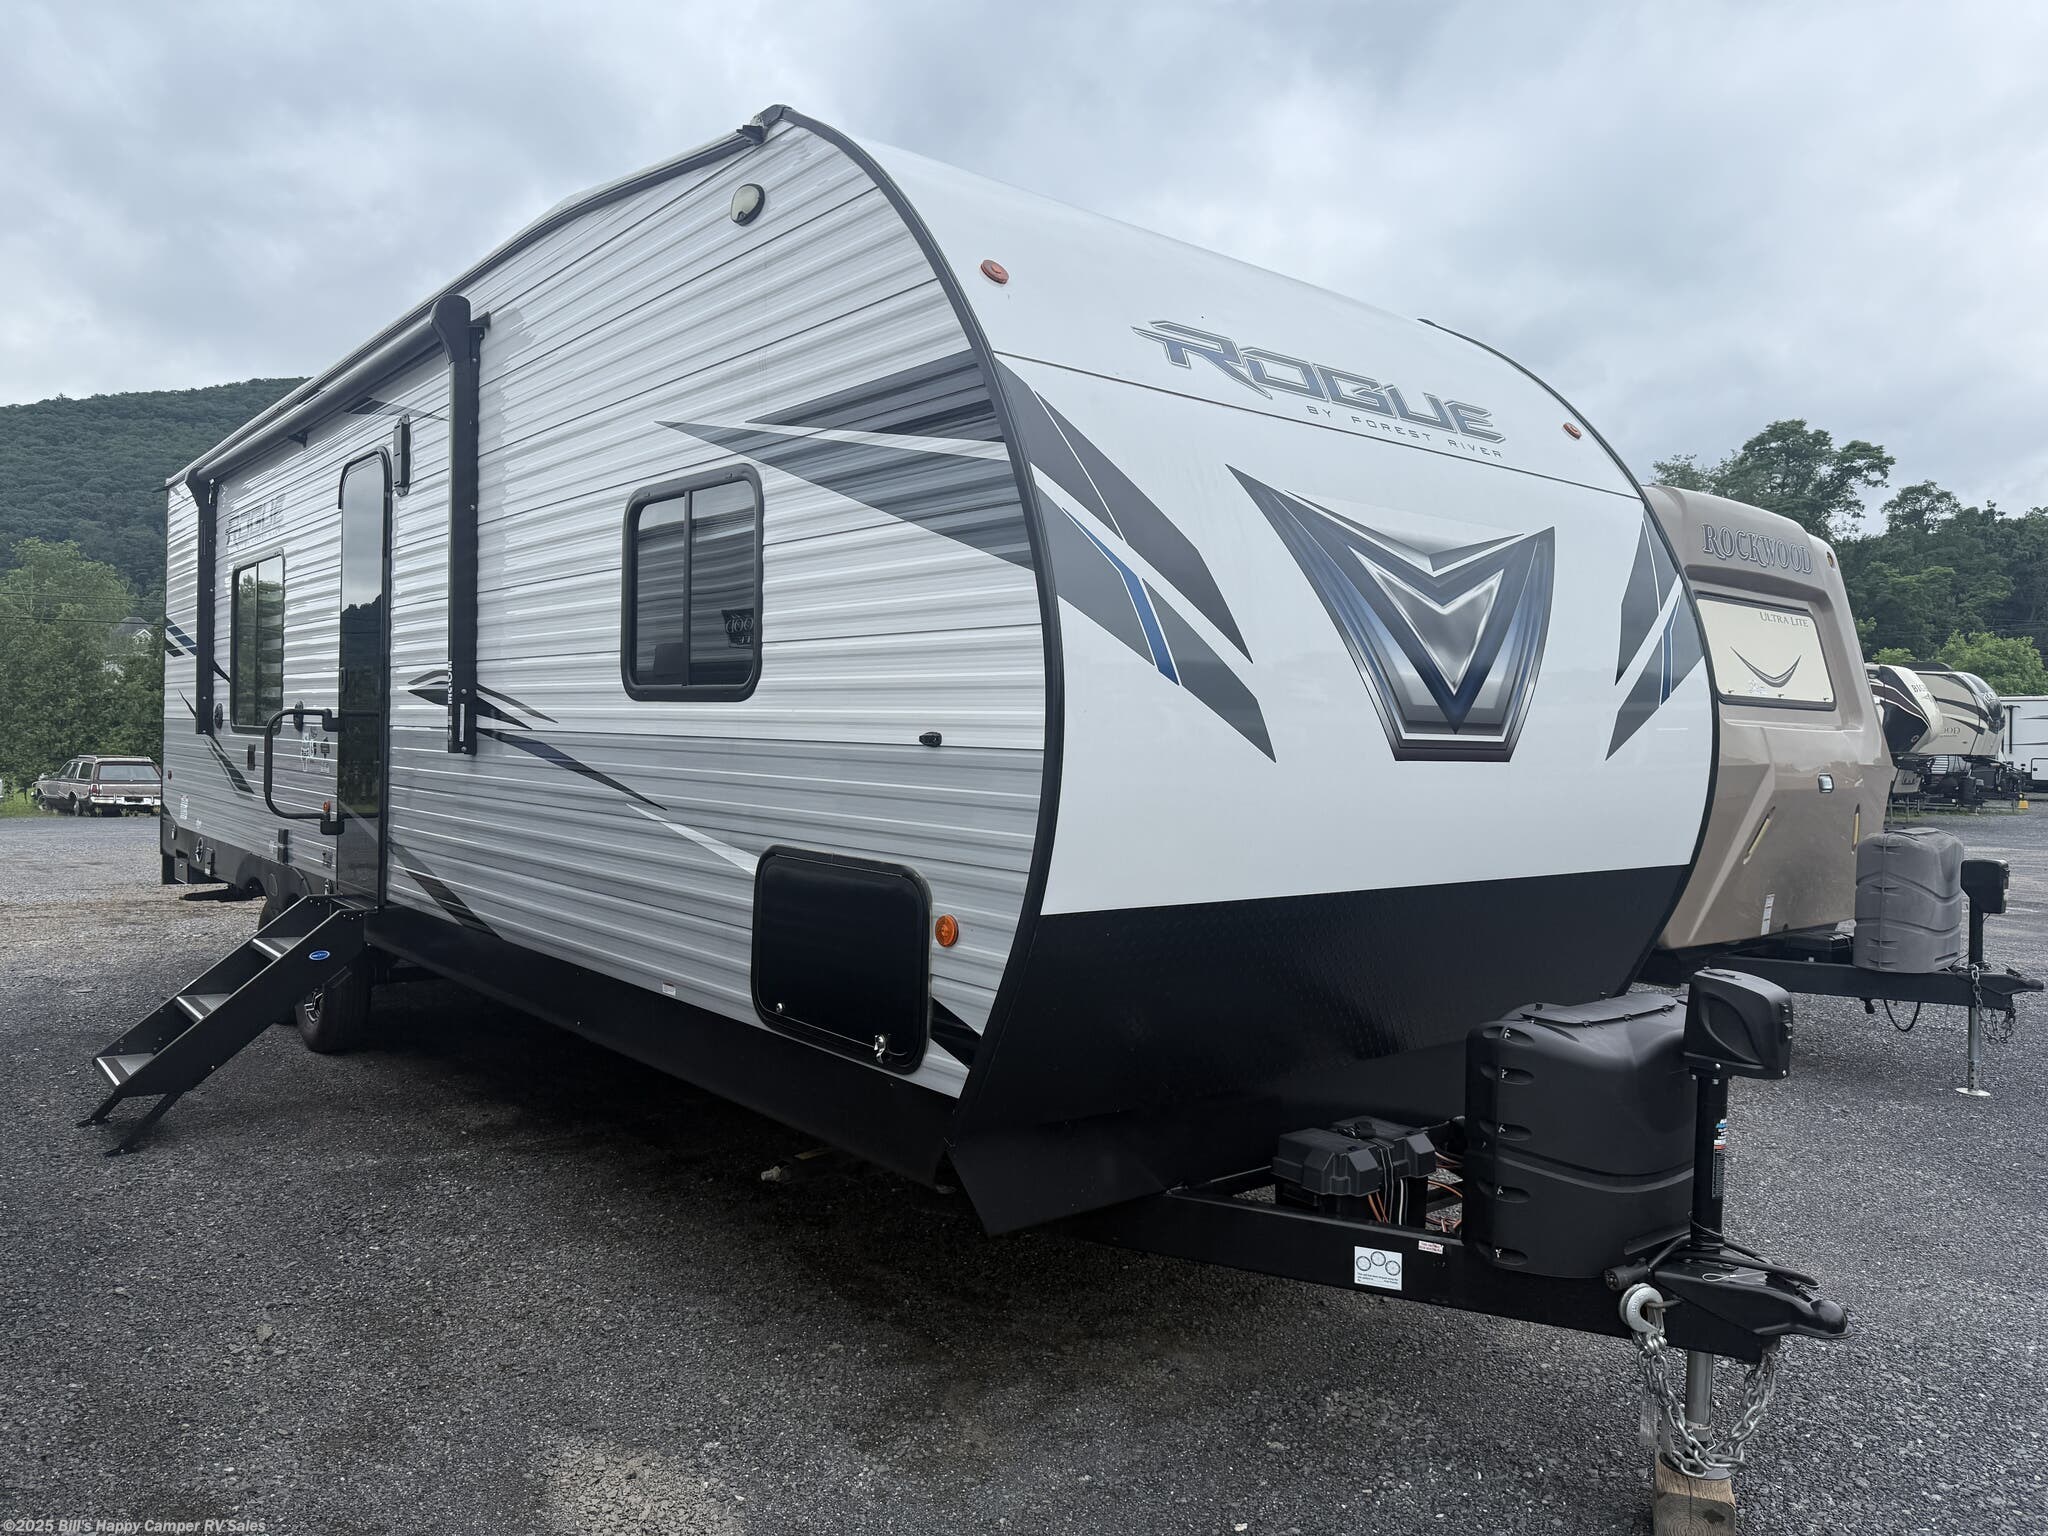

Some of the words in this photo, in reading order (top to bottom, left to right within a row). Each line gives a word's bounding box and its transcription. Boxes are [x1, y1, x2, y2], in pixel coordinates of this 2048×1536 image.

[1131, 320, 1506, 443] ROGUE
[1306, 405, 1333, 418] BY
[1351, 415, 1432, 441] FOREST
[1447, 438, 1504, 459] RIVER
[1702, 524, 1813, 574] ROCKWOOD
[1759, 611, 1789, 625] ULTRA
[1790, 615, 1809, 628] LITE
